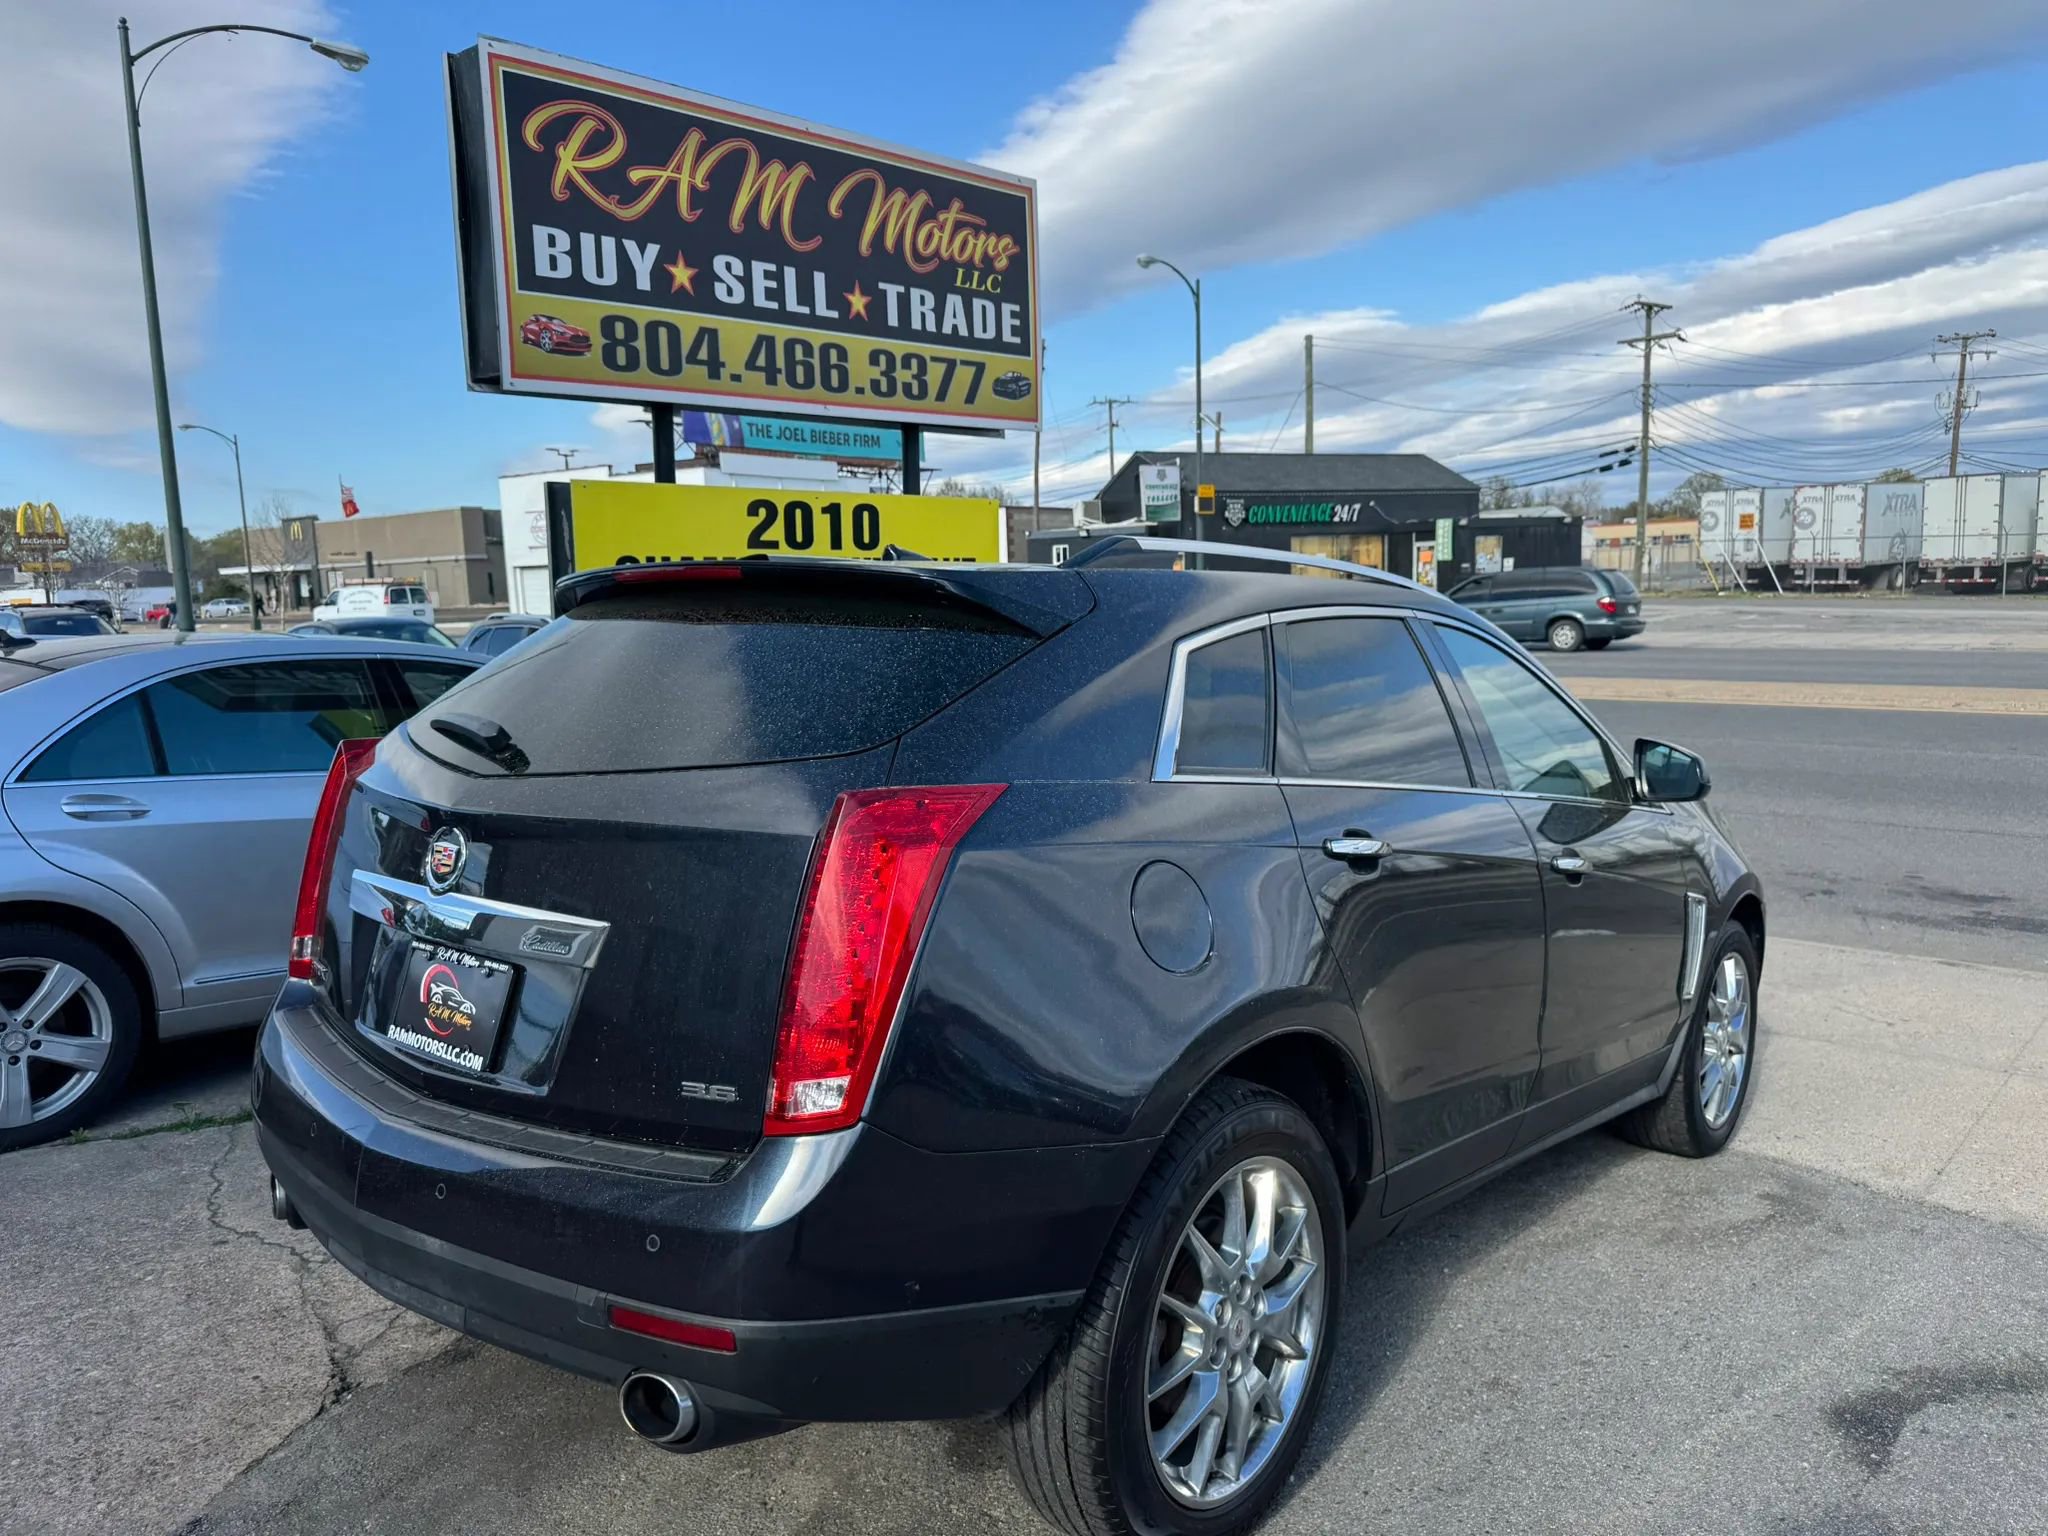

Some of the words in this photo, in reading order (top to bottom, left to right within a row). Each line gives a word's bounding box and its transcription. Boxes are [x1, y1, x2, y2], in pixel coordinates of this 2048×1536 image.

[521, 99, 823, 252] RAM
[828, 168, 1020, 274] Motors
[532, 223, 661, 292] BUY
[712, 254, 839, 319] SELL
[878, 281, 1021, 344] TRADE
[954, 267, 1002, 294] LLC
[600, 314, 986, 405] 804.466.3377
[746, 422, 773, 440] THE
[776, 425, 807, 443] JOEL
[810, 429, 850, 448] BIEBER
[853, 432, 881, 449] FIRM
[746, 498, 880, 551] 2010
[1248, 503, 1334, 524] CONVENIENCE
[1332, 502, 1361, 523] 24/7
[520, 932, 571, 955] Cadillac
